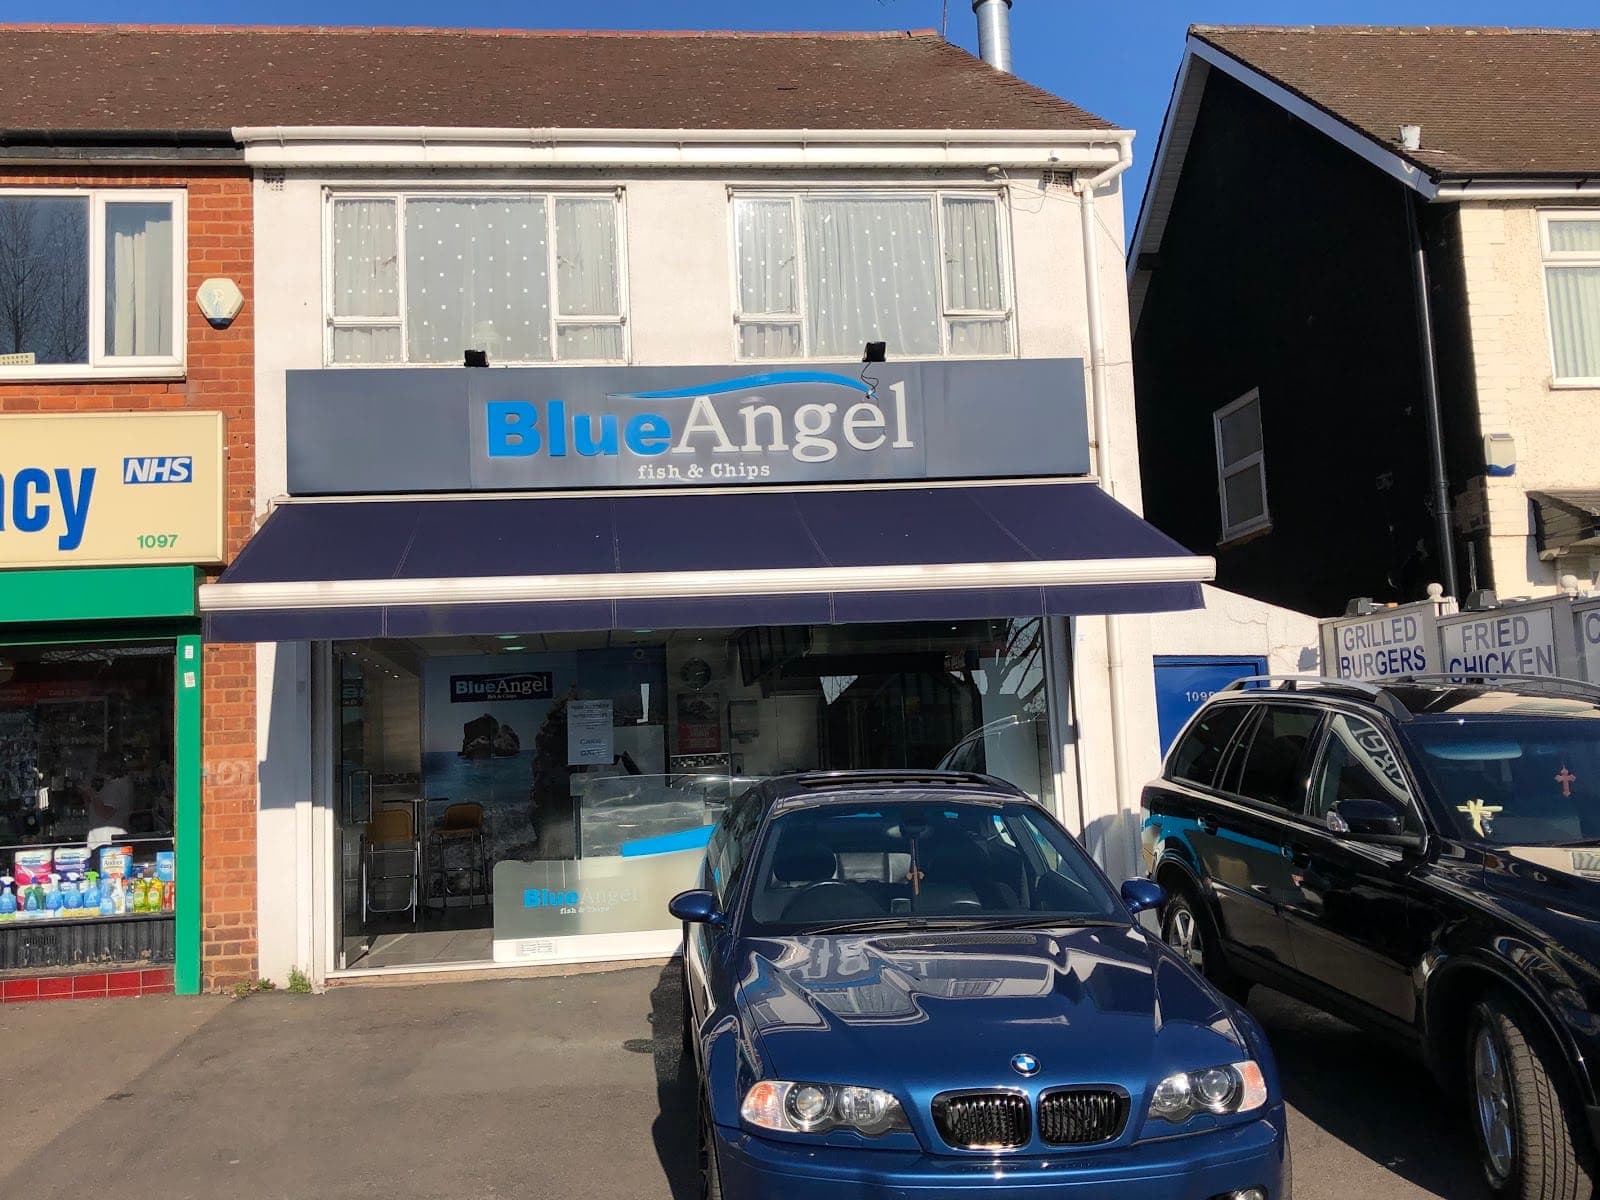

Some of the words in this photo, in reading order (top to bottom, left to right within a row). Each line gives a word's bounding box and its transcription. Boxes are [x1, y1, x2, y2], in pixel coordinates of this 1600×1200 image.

[124, 457, 191, 482] NHS
[637, 464, 680, 480] fish
[687, 463, 704, 478] &
[710, 461, 771, 480] Chips
[0, 467, 97, 551] cy
[136, 534, 178, 549] 1097
[1343, 615, 1417, 651] GRILLED
[1461, 616, 1529, 652] FRIED
[1340, 645, 1426, 680] BURGERS
[1449, 645, 1554, 684] CHICKEN
[560, 907, 577, 915] fish
